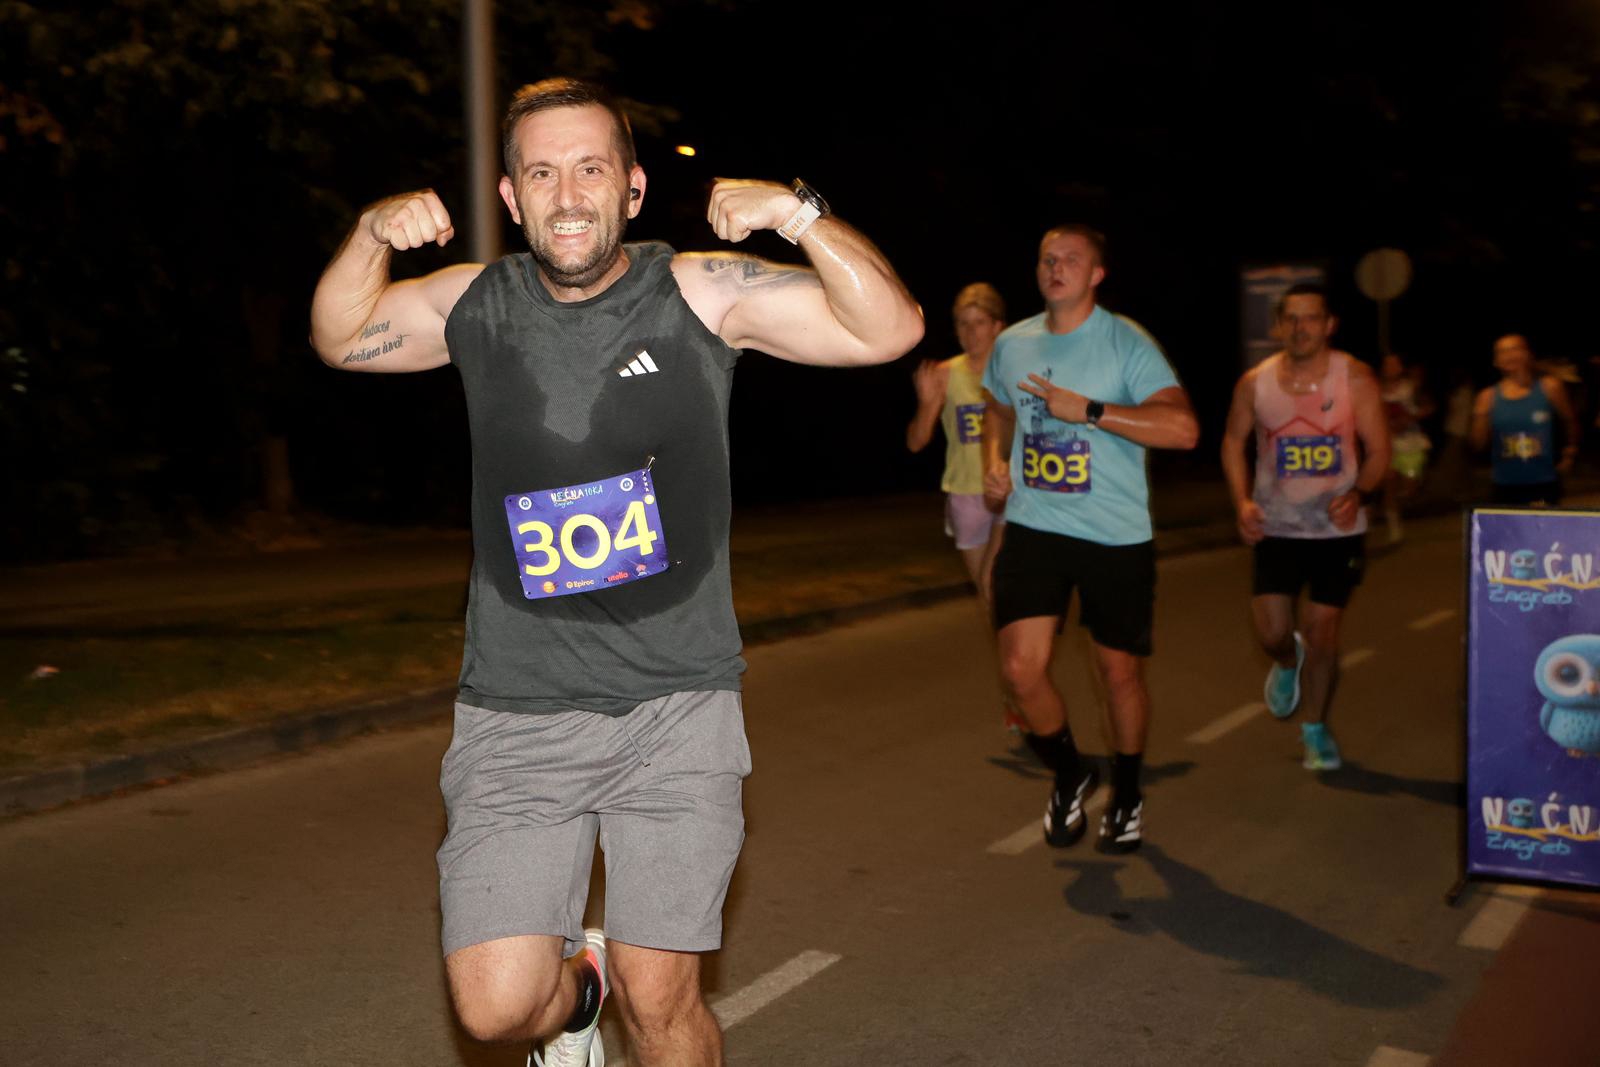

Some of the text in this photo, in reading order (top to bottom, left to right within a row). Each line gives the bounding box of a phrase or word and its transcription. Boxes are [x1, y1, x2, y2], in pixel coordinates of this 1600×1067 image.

[1024, 447, 1088, 484] 303
[1284, 445, 1334, 470] 319
[517, 500, 657, 576] 304
[1488, 583, 1573, 612] Zagreb
[1486, 830, 1571, 861] Zagreb
